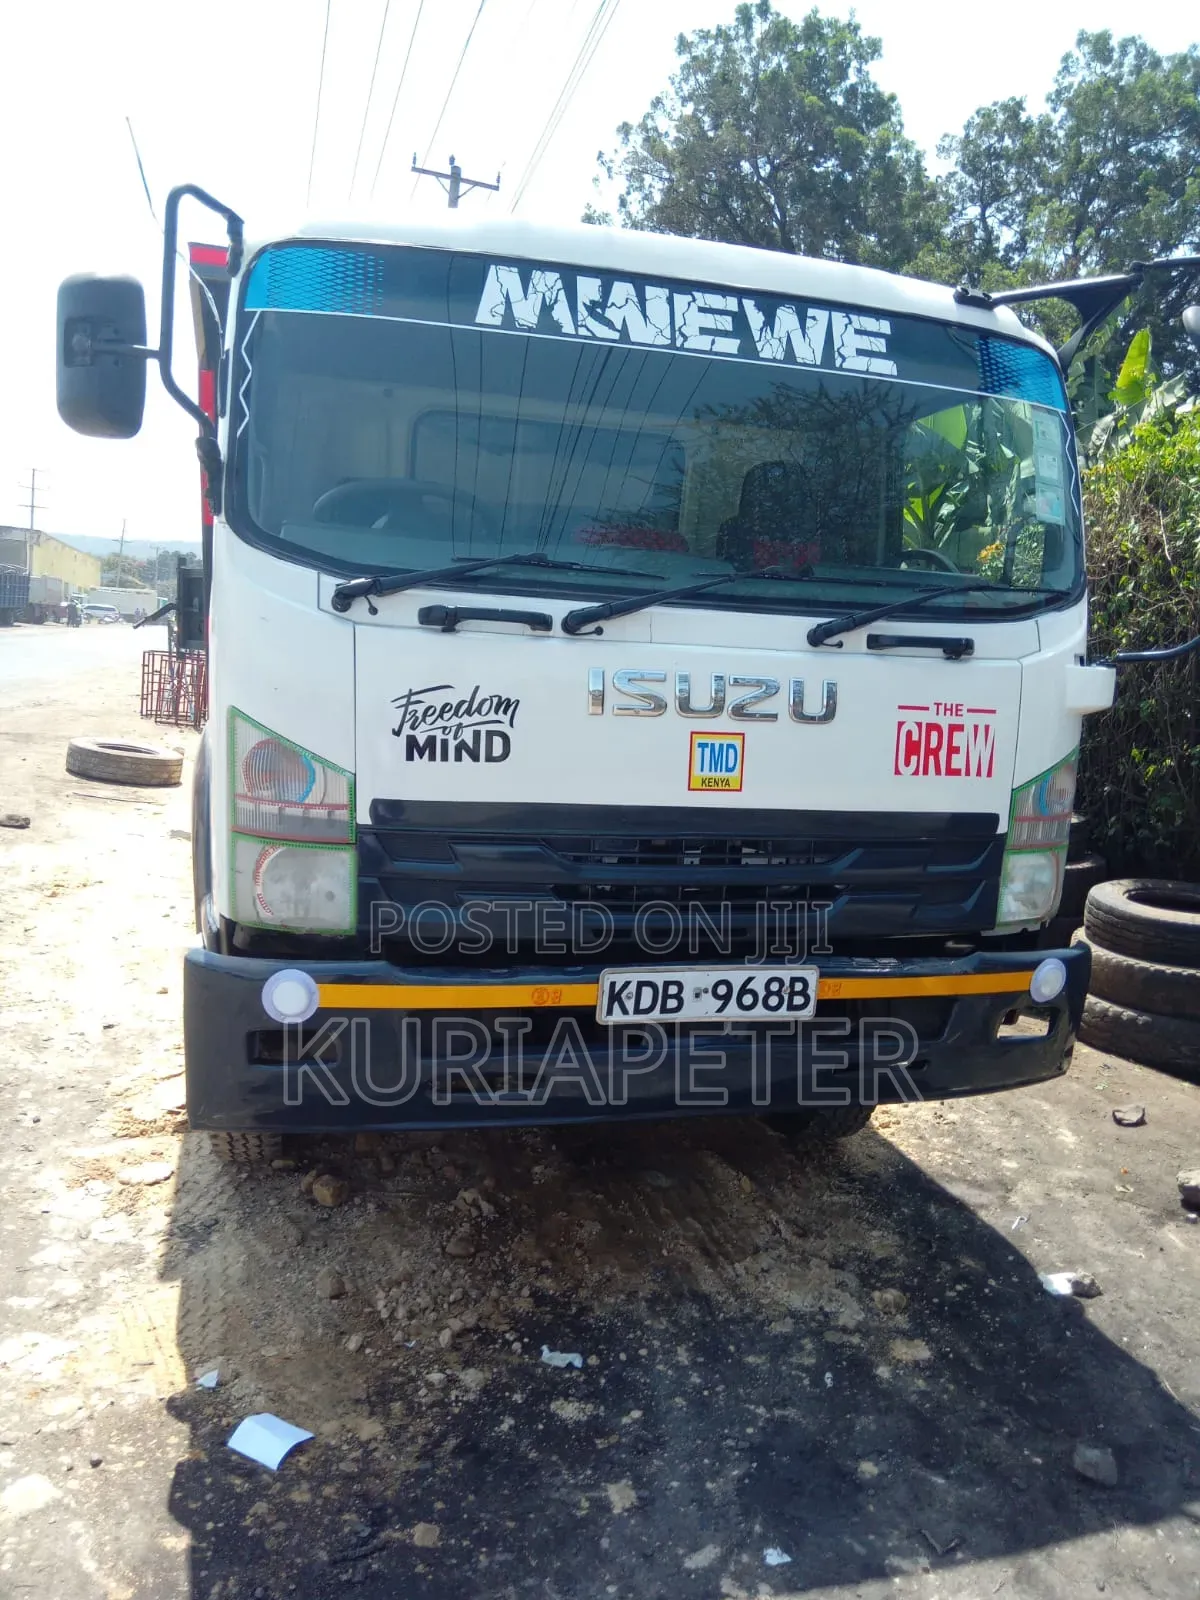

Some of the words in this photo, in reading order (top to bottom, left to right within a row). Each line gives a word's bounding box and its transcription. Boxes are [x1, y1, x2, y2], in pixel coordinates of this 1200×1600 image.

[391, 685, 520, 737] Freedom
[587, 666, 838, 725] ISUZU
[933, 702, 964, 717] THE
[697, 742, 738, 773] TMD
[894, 720, 996, 778] CREW
[701, 777, 730, 788] KENYA
[605, 979, 685, 1017] KDB
[710, 976, 812, 1015] 968B
